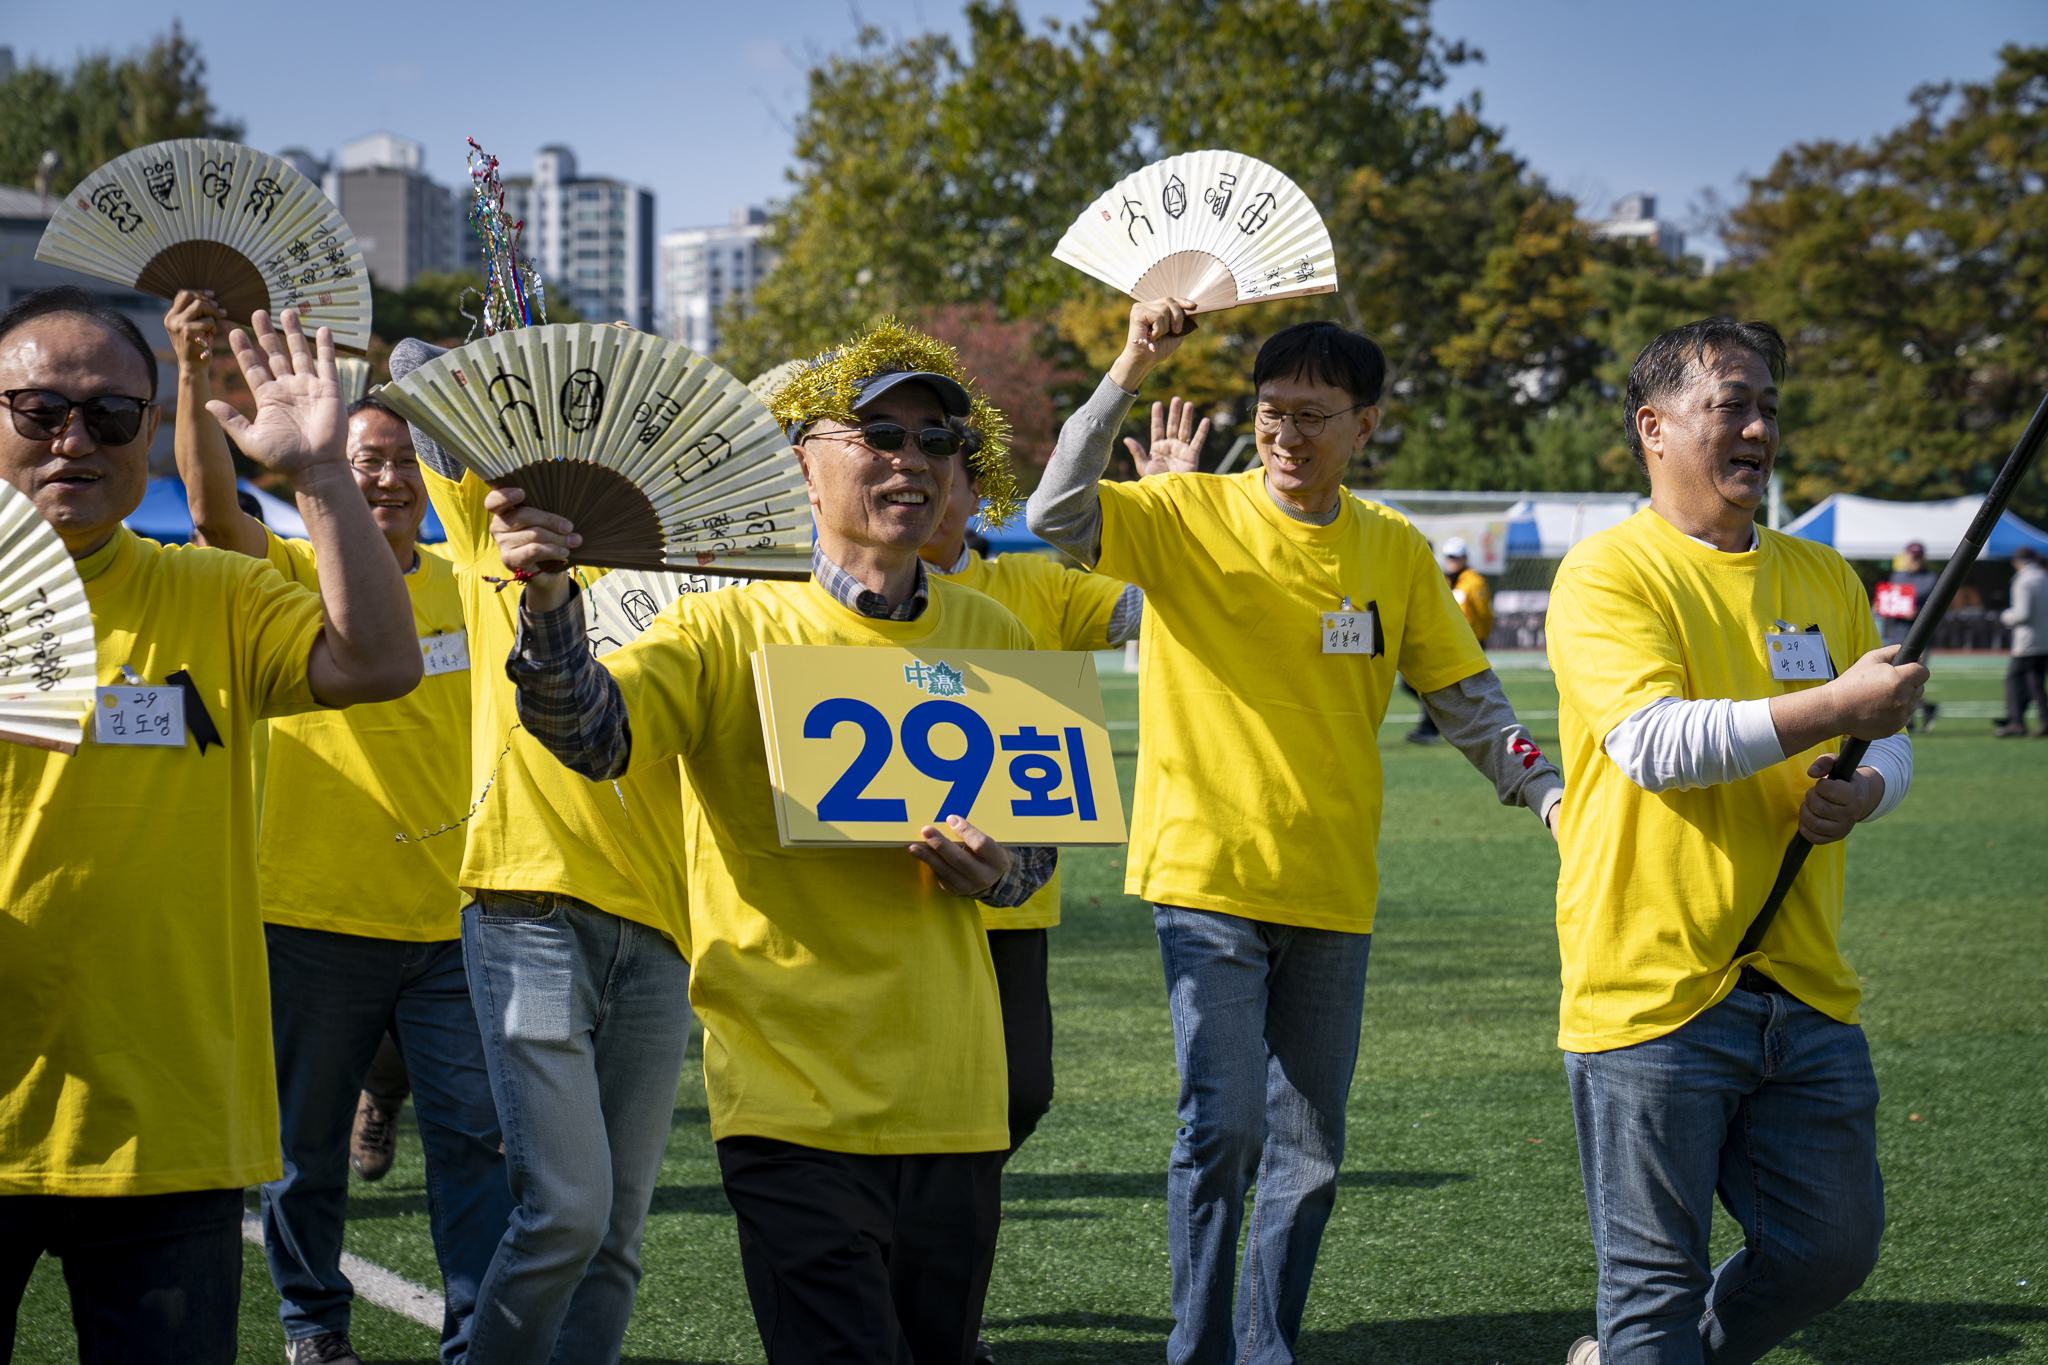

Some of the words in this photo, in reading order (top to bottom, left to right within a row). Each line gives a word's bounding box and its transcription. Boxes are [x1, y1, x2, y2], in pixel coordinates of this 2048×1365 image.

[1340, 617, 1355, 628] 29
[1787, 641, 1799, 651] 29
[133, 691, 158, 709] 29
[803, 697, 1098, 823] 29회
